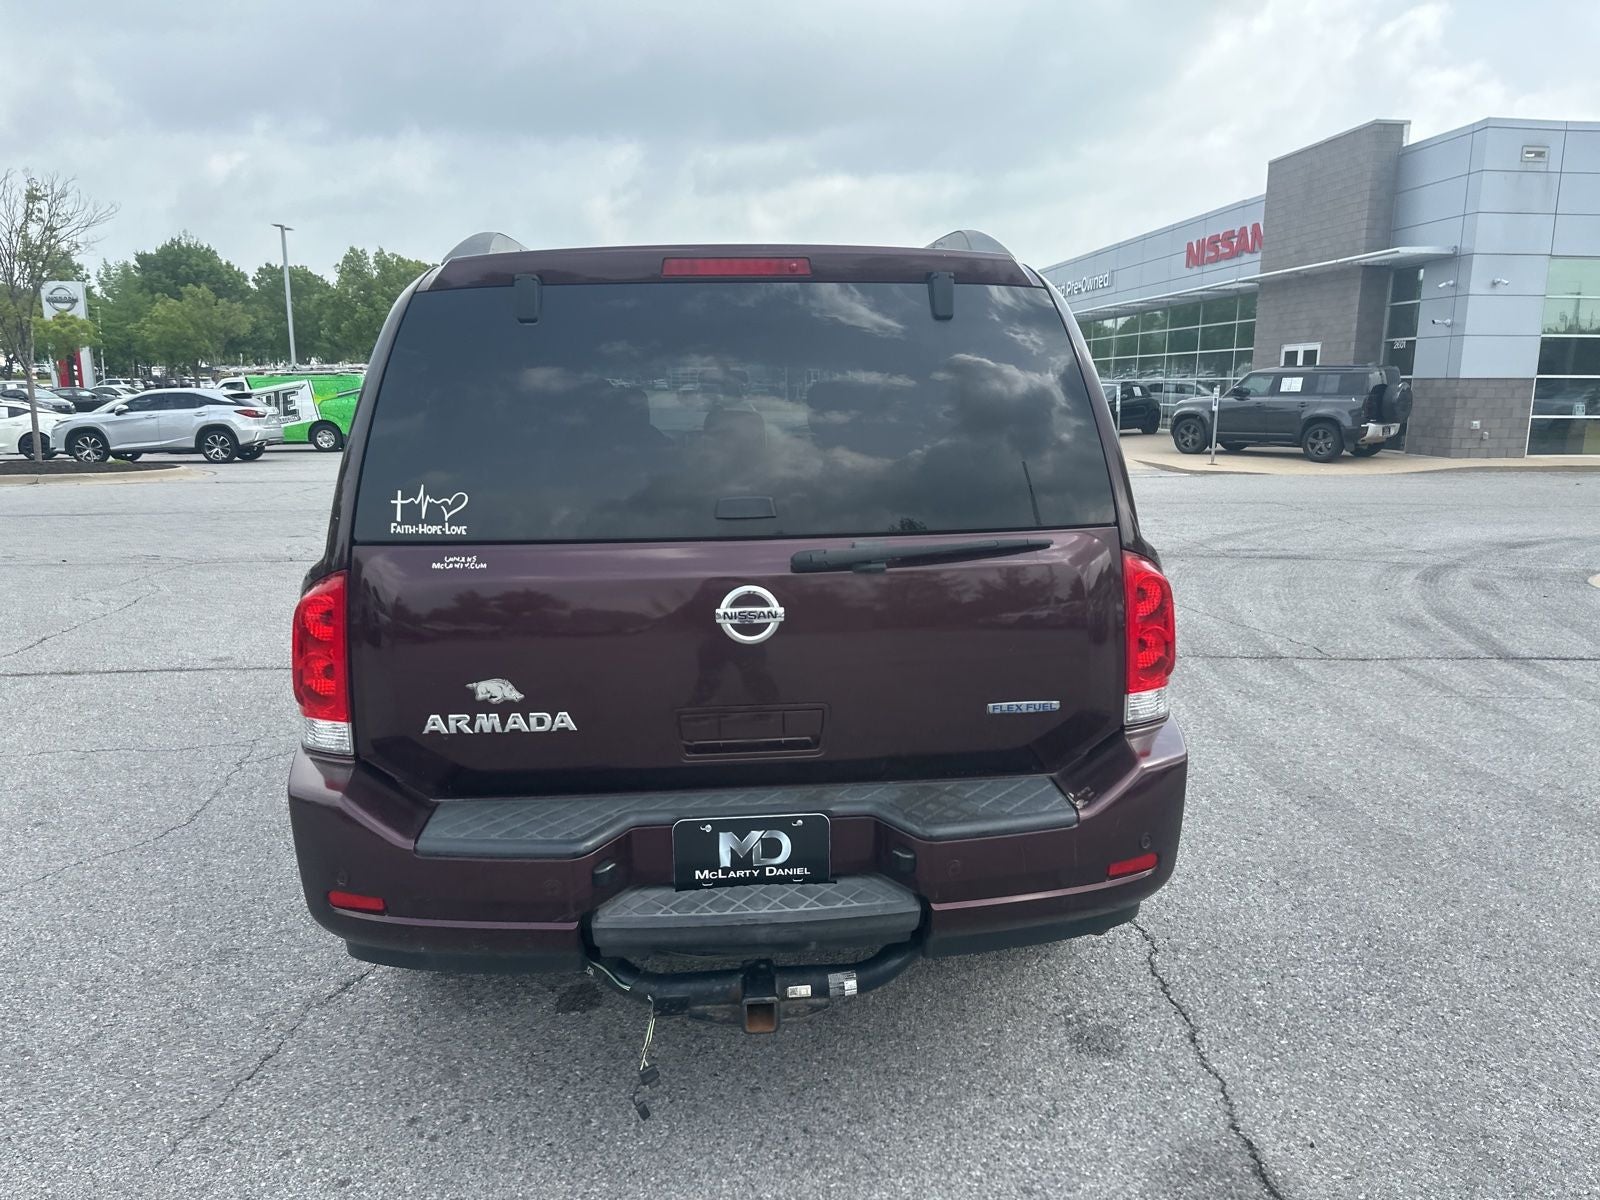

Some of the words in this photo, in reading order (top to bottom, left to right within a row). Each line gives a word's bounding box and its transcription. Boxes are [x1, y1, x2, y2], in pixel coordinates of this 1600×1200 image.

[1066, 270, 1112, 296] Pre-Owned
[722, 610, 778, 621] NISSAN
[992, 704, 1023, 713] FLEX
[1026, 702, 1057, 712] FUEL
[422, 711, 578, 735] ARMADA
[718, 829, 792, 868] MD
[765, 866, 811, 877] DANIEL
